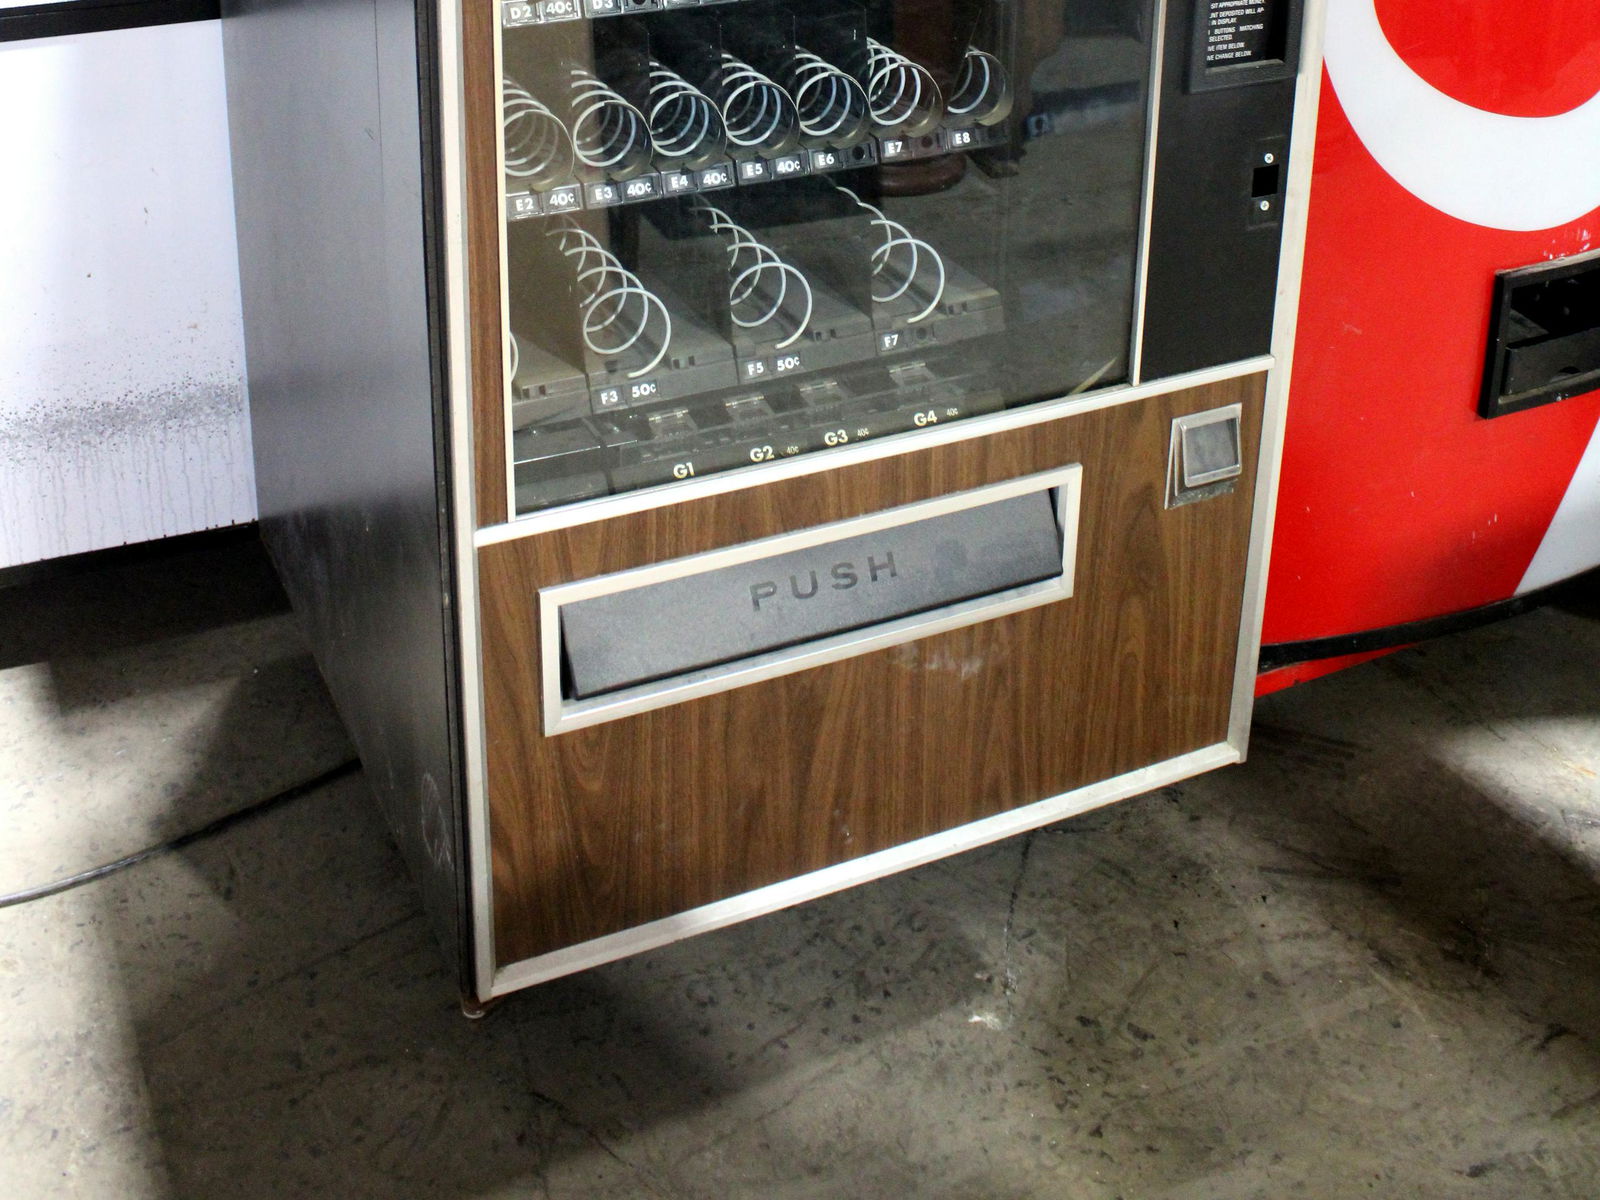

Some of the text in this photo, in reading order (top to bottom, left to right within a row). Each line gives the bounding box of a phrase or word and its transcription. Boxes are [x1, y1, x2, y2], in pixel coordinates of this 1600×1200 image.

[510, 1, 574, 19] D2 40¢
[1219, 0, 1248, 8] APPROPRIATE
[1219, 9, 1244, 17] DEPOSITED
[1214, 26, 1236, 35] BUTTONS
[1239, 23, 1264, 31] MATCHING
[1215, 52, 1234, 60] CHANGE
[955, 131, 971, 145] E8
[886, 141, 903, 154] E7
[746, 160, 801, 176] E5 40¢
[818, 153, 835, 166] E6
[671, 171, 728, 189] E4 40¢
[595, 182, 652, 200] E3 40¢
[515, 192, 575, 211] E2 40¢
[884, 334, 899, 348] F7
[747, 356, 801, 376] F5 50¢
[600, 383, 656, 404] F3 50¢
[913, 410, 938, 427] G4
[824, 429, 848, 447] G3
[749, 445, 775, 463] G2
[673, 461, 695, 479] G1
[749, 551, 898, 612] PUSH
